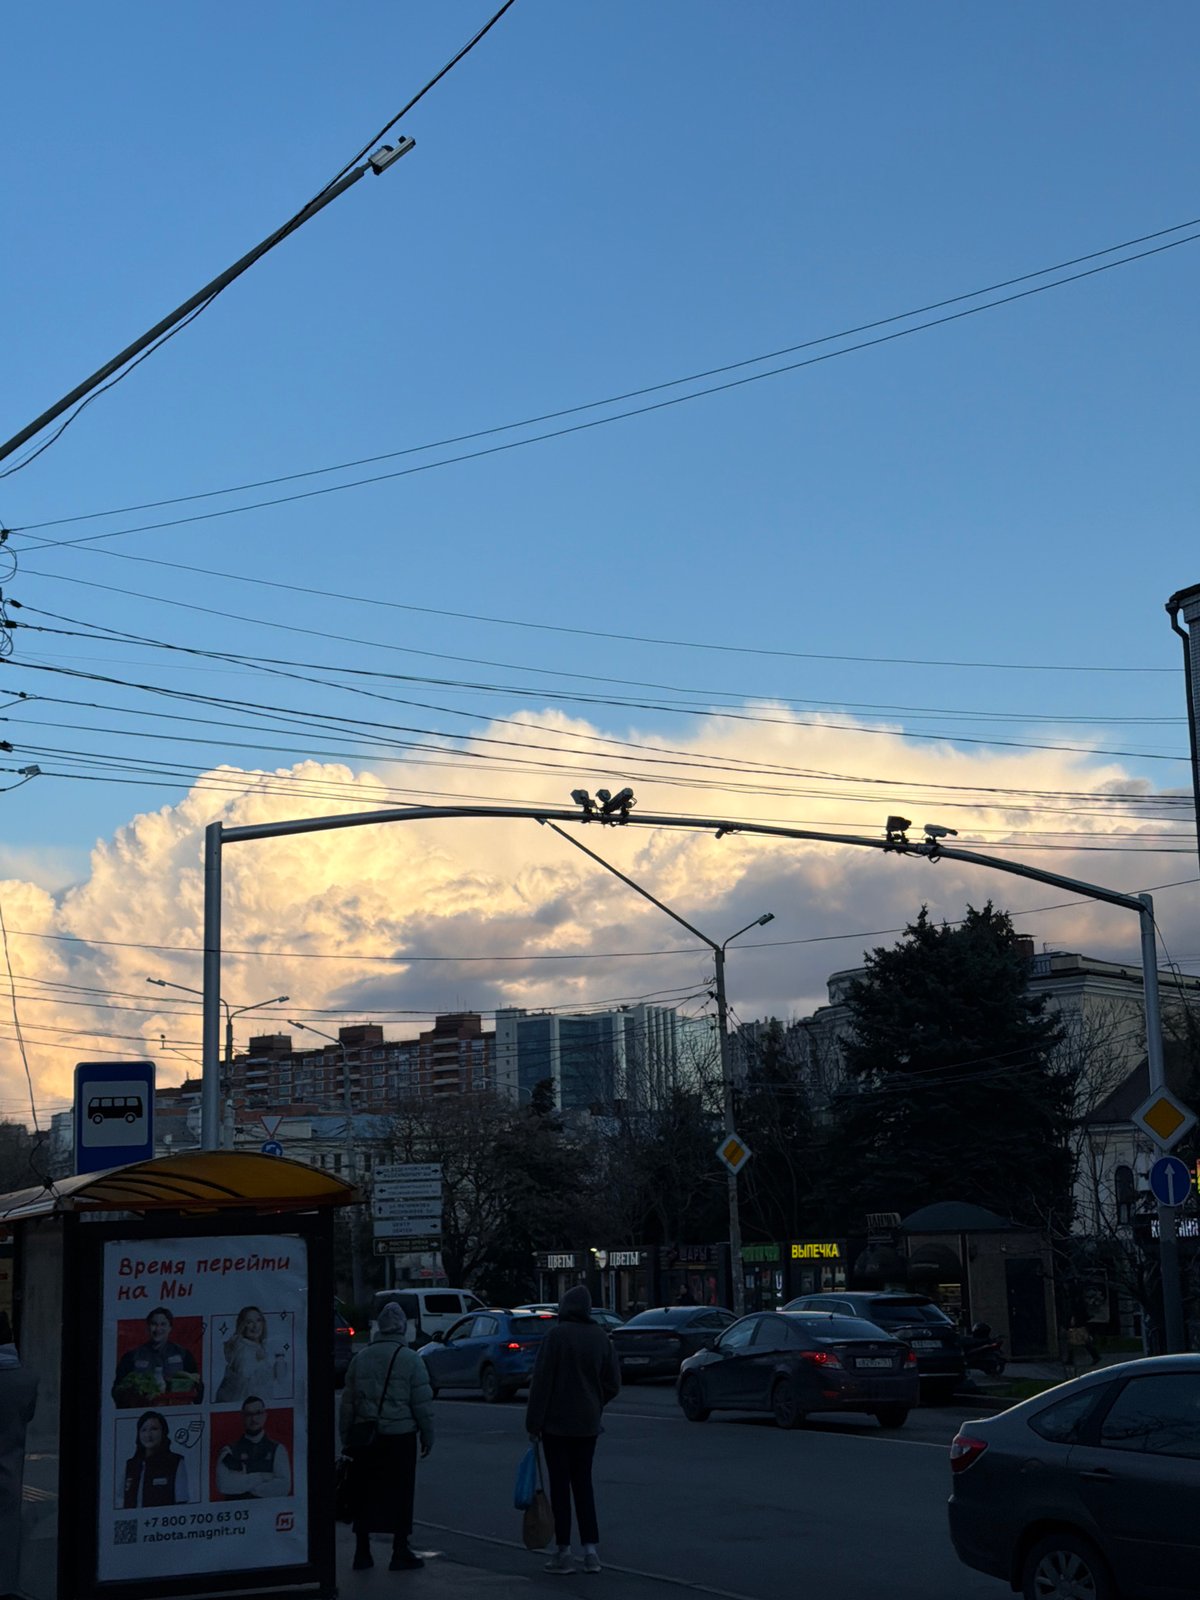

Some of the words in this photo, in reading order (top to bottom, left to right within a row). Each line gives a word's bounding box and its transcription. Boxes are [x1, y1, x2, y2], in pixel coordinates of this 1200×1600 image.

[609, 1251, 639, 1267] ЦВЕТЫ
[791, 1243, 840, 1258] ВЫПЕЧКА
[118, 1258, 186, 1279] Время
[196, 1255, 290, 1276] перейти
[547, 1254, 574, 1270] ЦВЕТЫ
[117, 1285, 148, 1300] на
[160, 1280, 193, 1300] Мы
[144, 1518, 158, 1528] +7
[162, 1516, 186, 1527] 800
[190, 1513, 212, 1525] 700
[216, 1511, 231, 1522] 63
[234, 1510, 249, 1521] 03
[143, 1526, 246, 1543] rabota.magnit.ru
